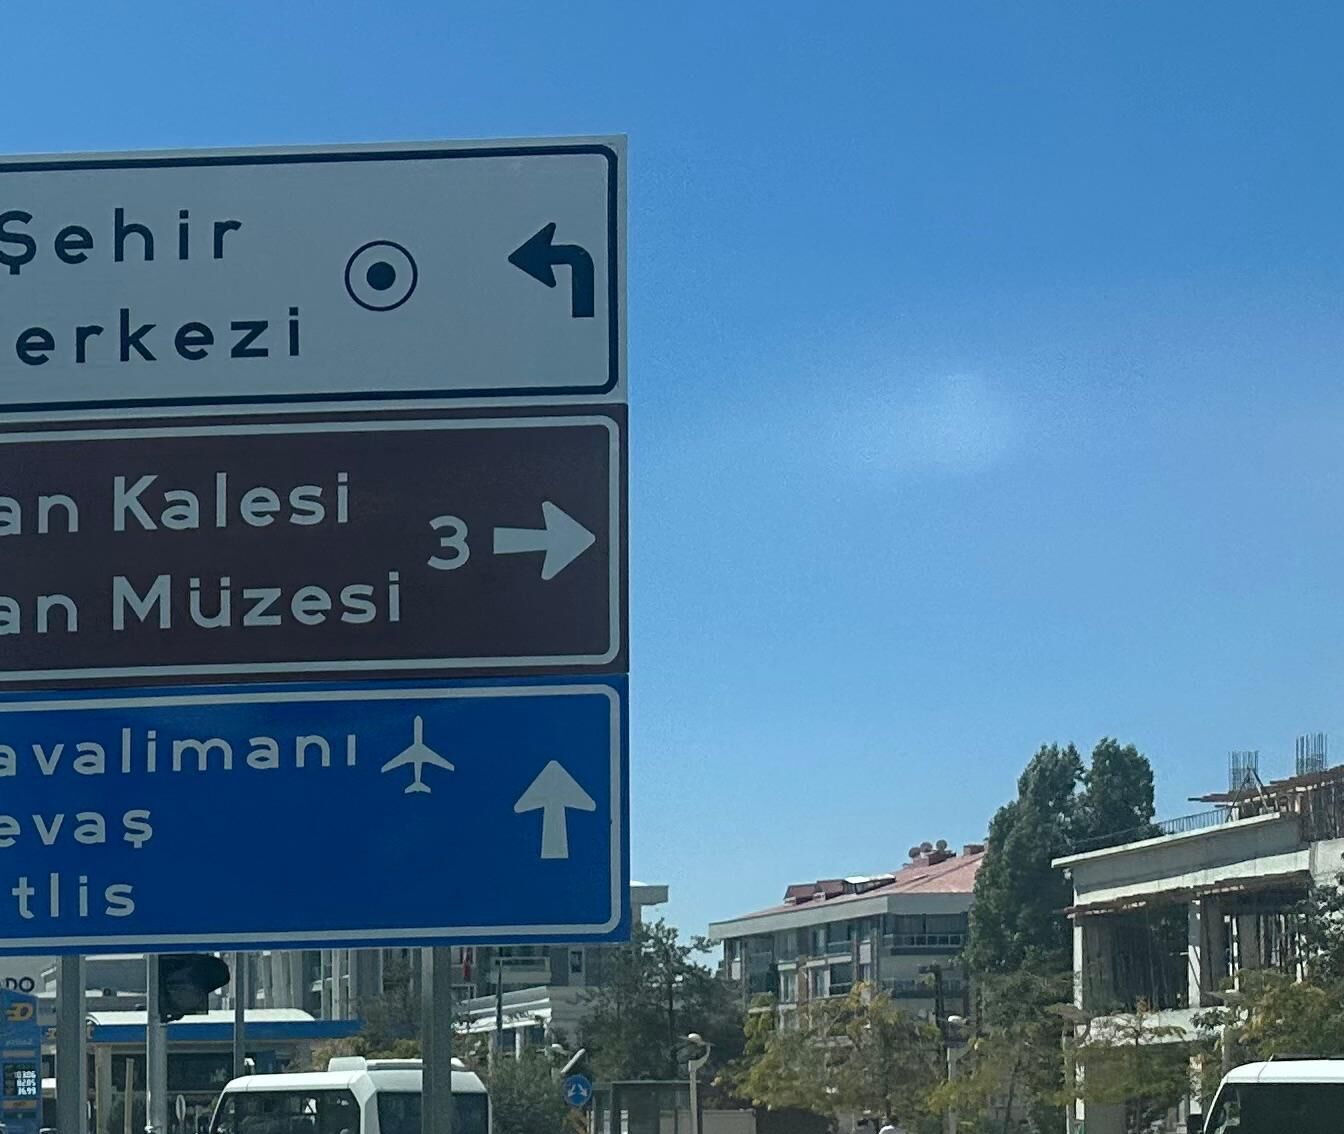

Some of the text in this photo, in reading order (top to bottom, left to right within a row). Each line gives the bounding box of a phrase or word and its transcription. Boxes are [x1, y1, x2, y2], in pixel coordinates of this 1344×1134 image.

[113, 472, 349, 531] Kalesi
[427, 516, 470, 570] 3
[113, 572, 401, 631] Müzesi
